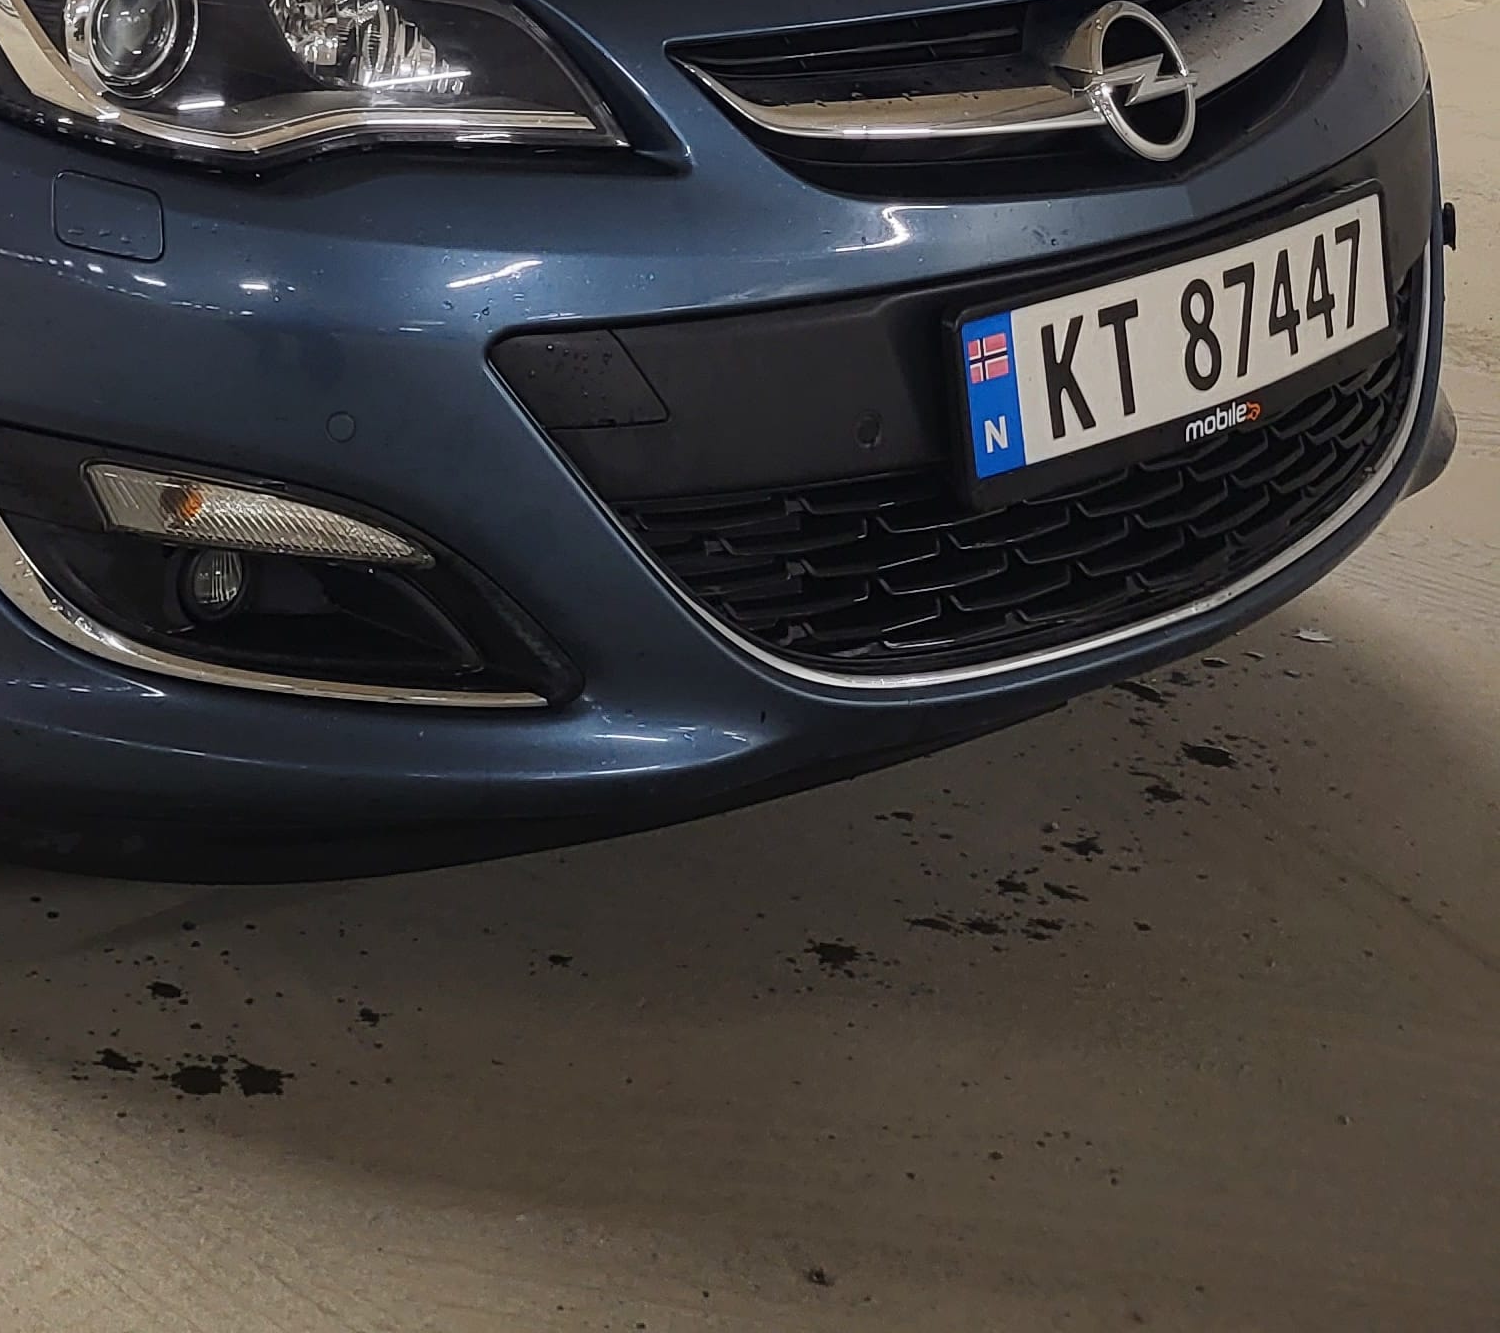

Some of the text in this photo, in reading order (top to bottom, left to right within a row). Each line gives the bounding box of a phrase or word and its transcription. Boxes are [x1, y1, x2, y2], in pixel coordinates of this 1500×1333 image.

[1040, 219, 1361, 439] KT 87447
[984, 415, 1009, 454] N
[1185, 401, 1248, 443] mobile
